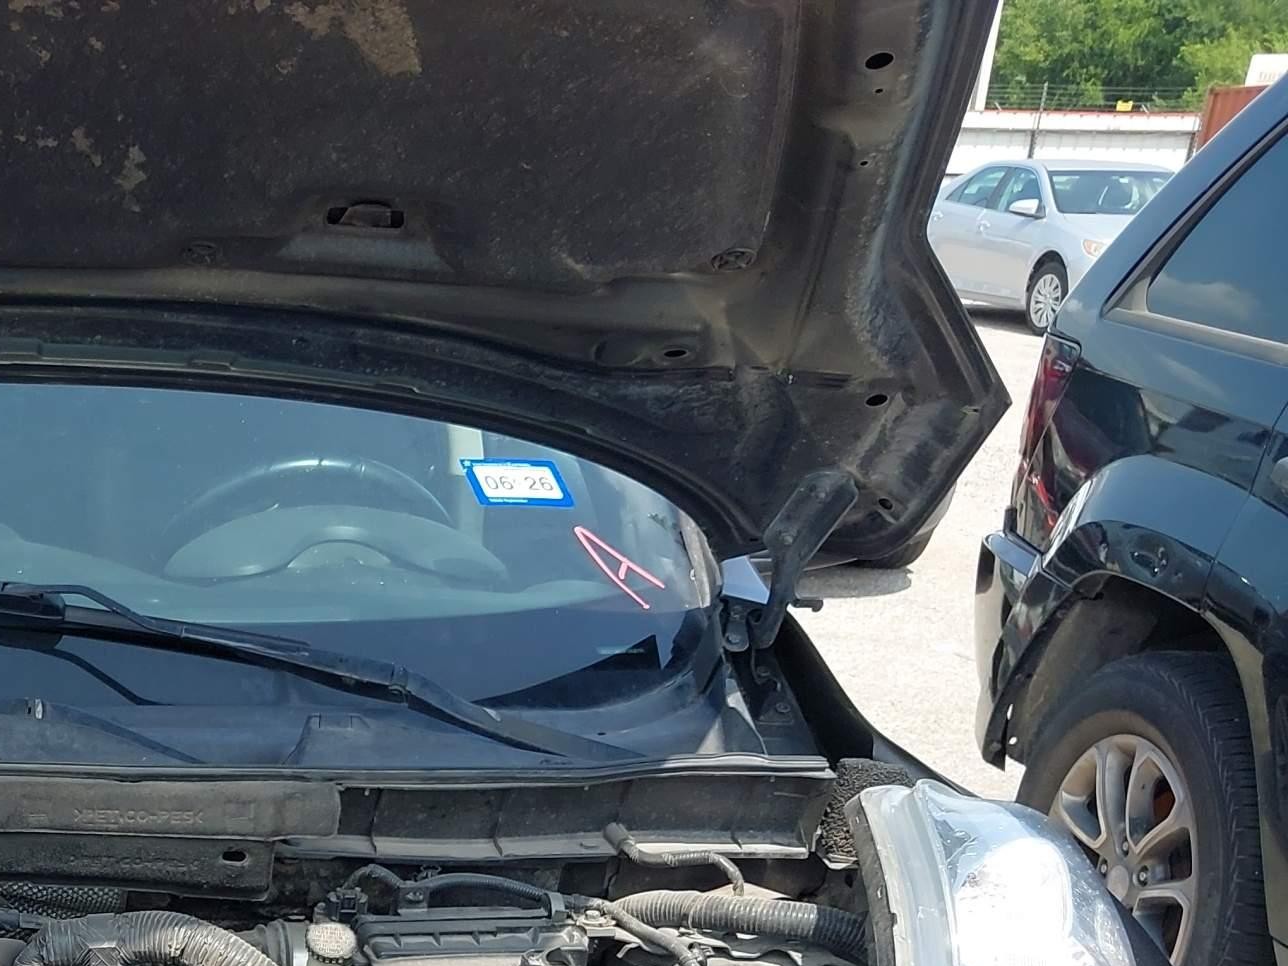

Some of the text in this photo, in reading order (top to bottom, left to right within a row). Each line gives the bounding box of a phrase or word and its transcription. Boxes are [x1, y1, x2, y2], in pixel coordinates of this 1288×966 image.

[484, 475, 554, 492] 06 26
[574, 526, 665, 609] A
